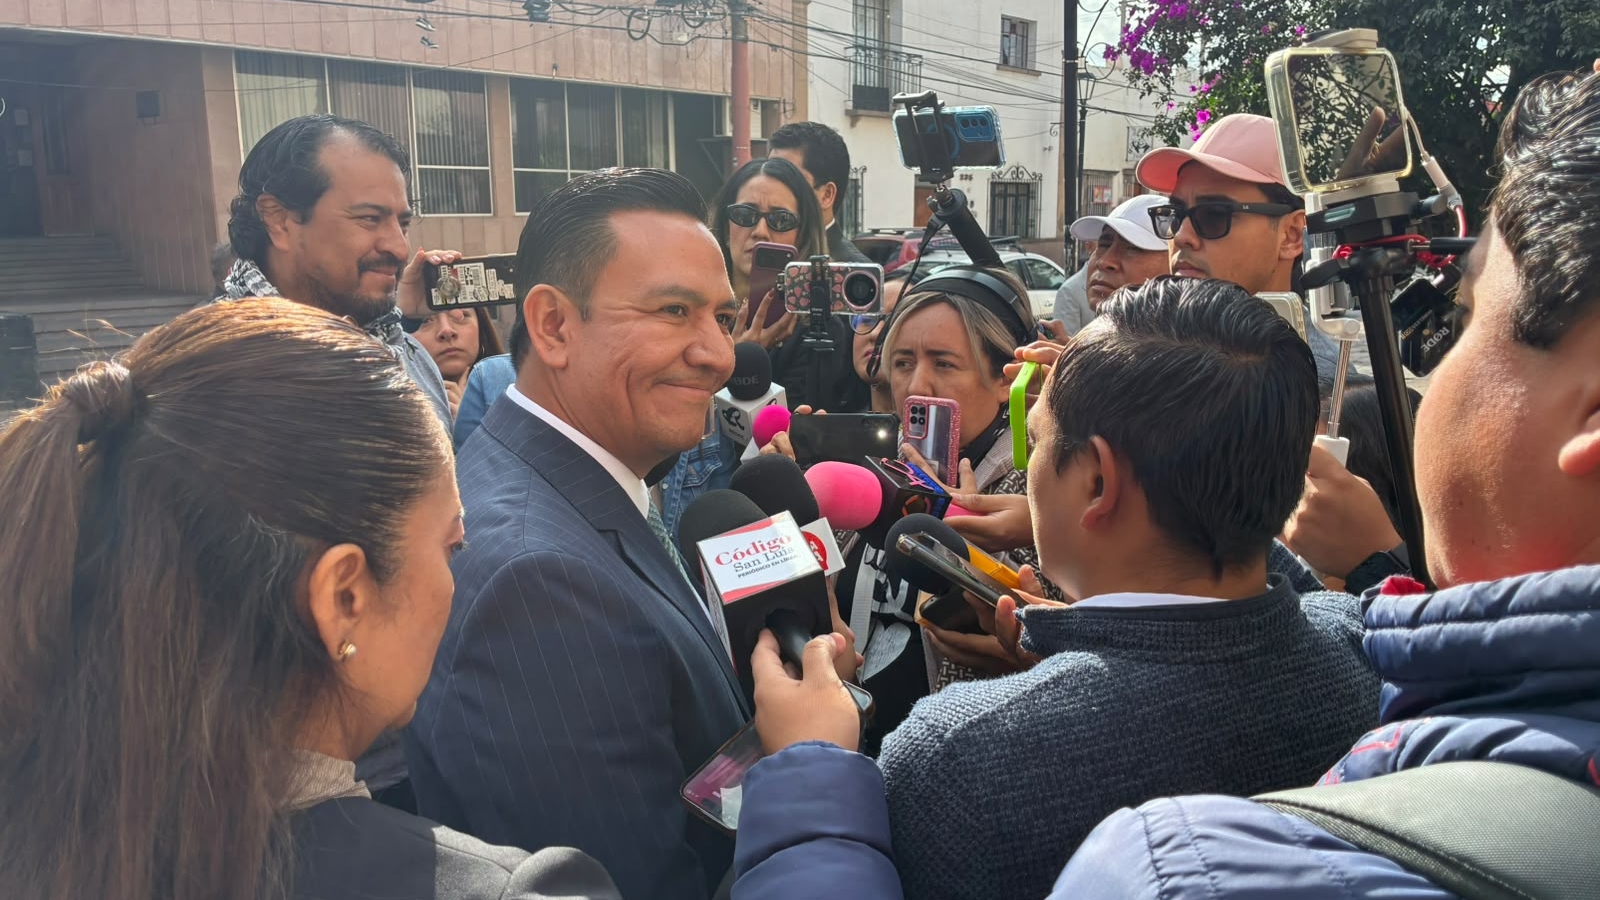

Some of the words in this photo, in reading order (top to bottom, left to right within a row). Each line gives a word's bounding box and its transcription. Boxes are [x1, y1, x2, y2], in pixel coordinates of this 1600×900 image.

[715, 535, 793, 566] Código
[733, 558, 762, 573] San
[762, 546, 794, 563] Luis
[737, 563, 771, 579] PERIÓDICO
[770, 560, 781, 568] EN
